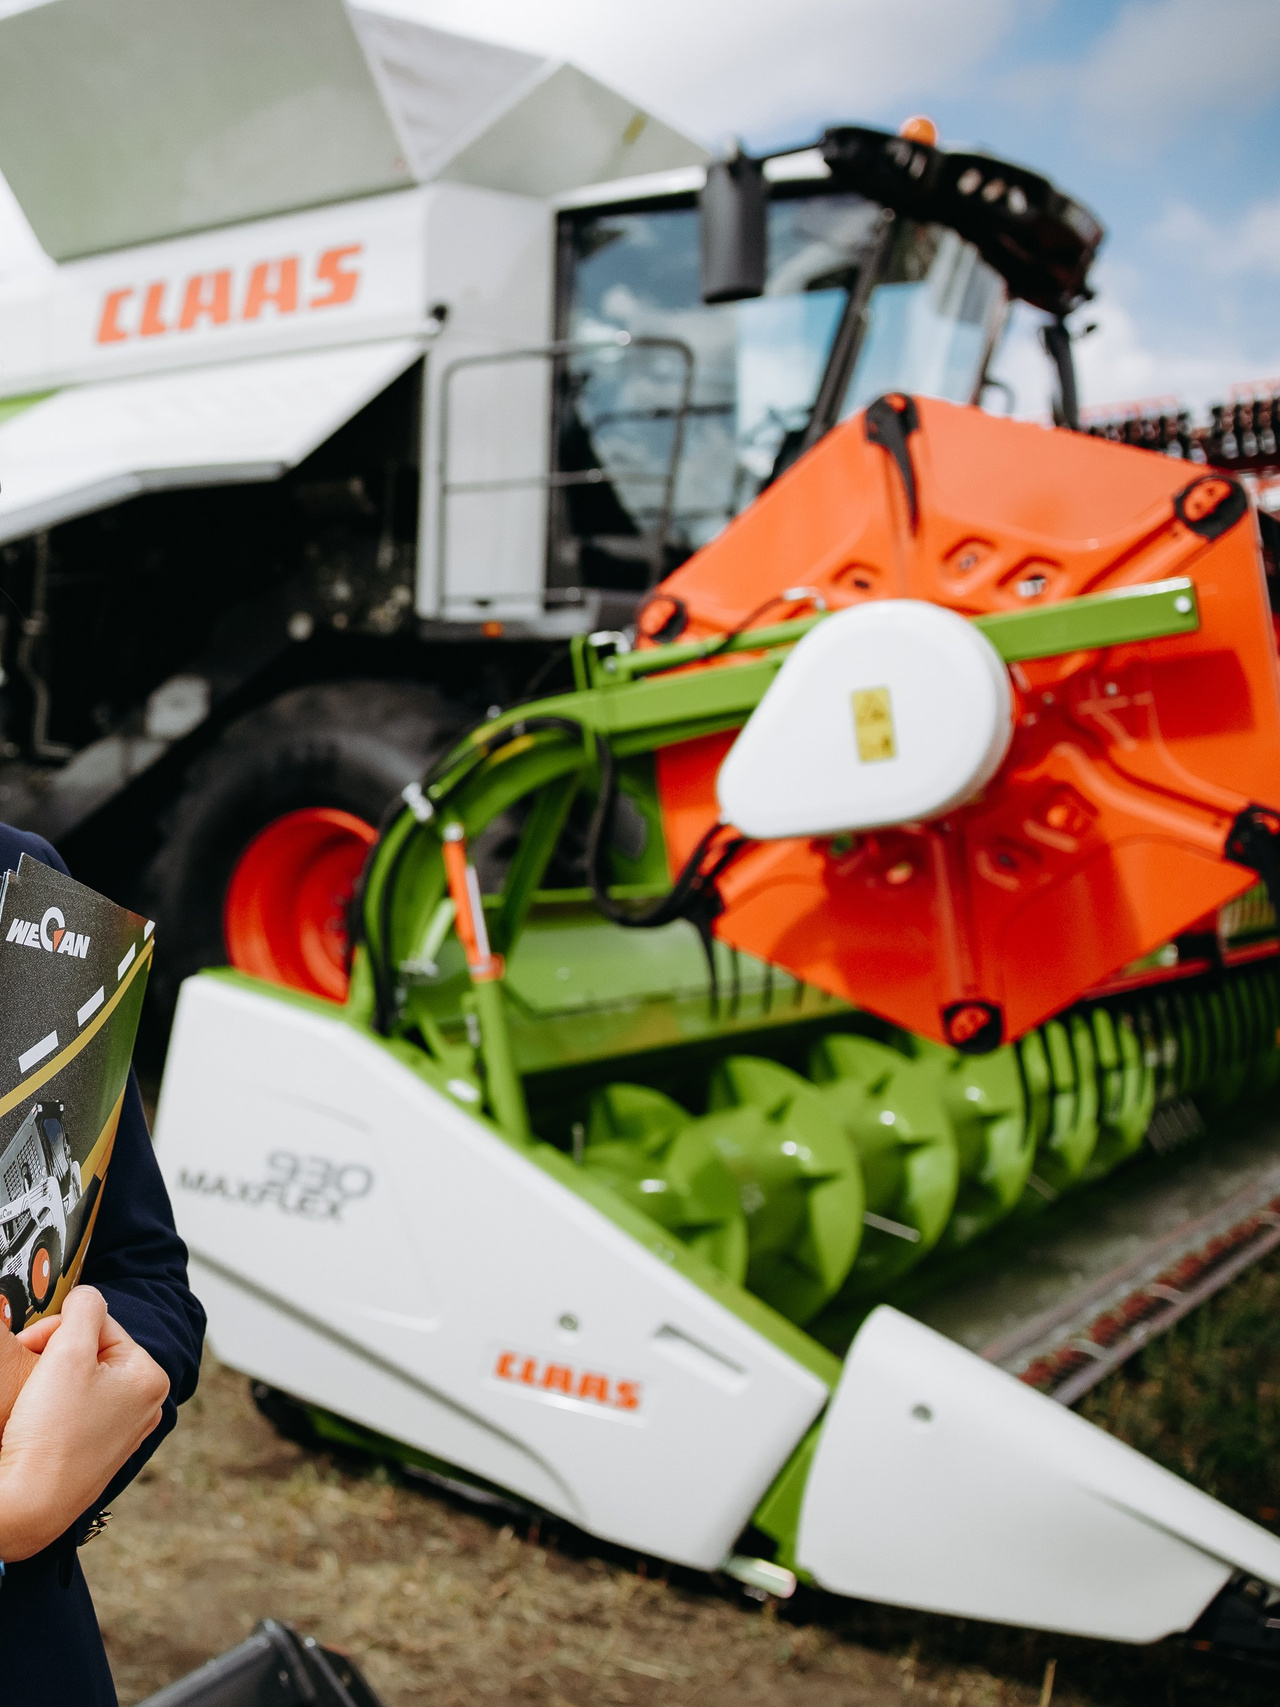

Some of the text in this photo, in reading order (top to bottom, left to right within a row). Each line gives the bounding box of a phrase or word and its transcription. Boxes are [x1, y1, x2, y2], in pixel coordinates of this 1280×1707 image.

[95, 245, 363, 344] CLAAS
[5, 906, 91, 959] WECAN
[177, 1165, 342, 1223] MAXFLEX
[267, 1149, 375, 1199] 930
[494, 1351, 640, 1412] CLAAS
